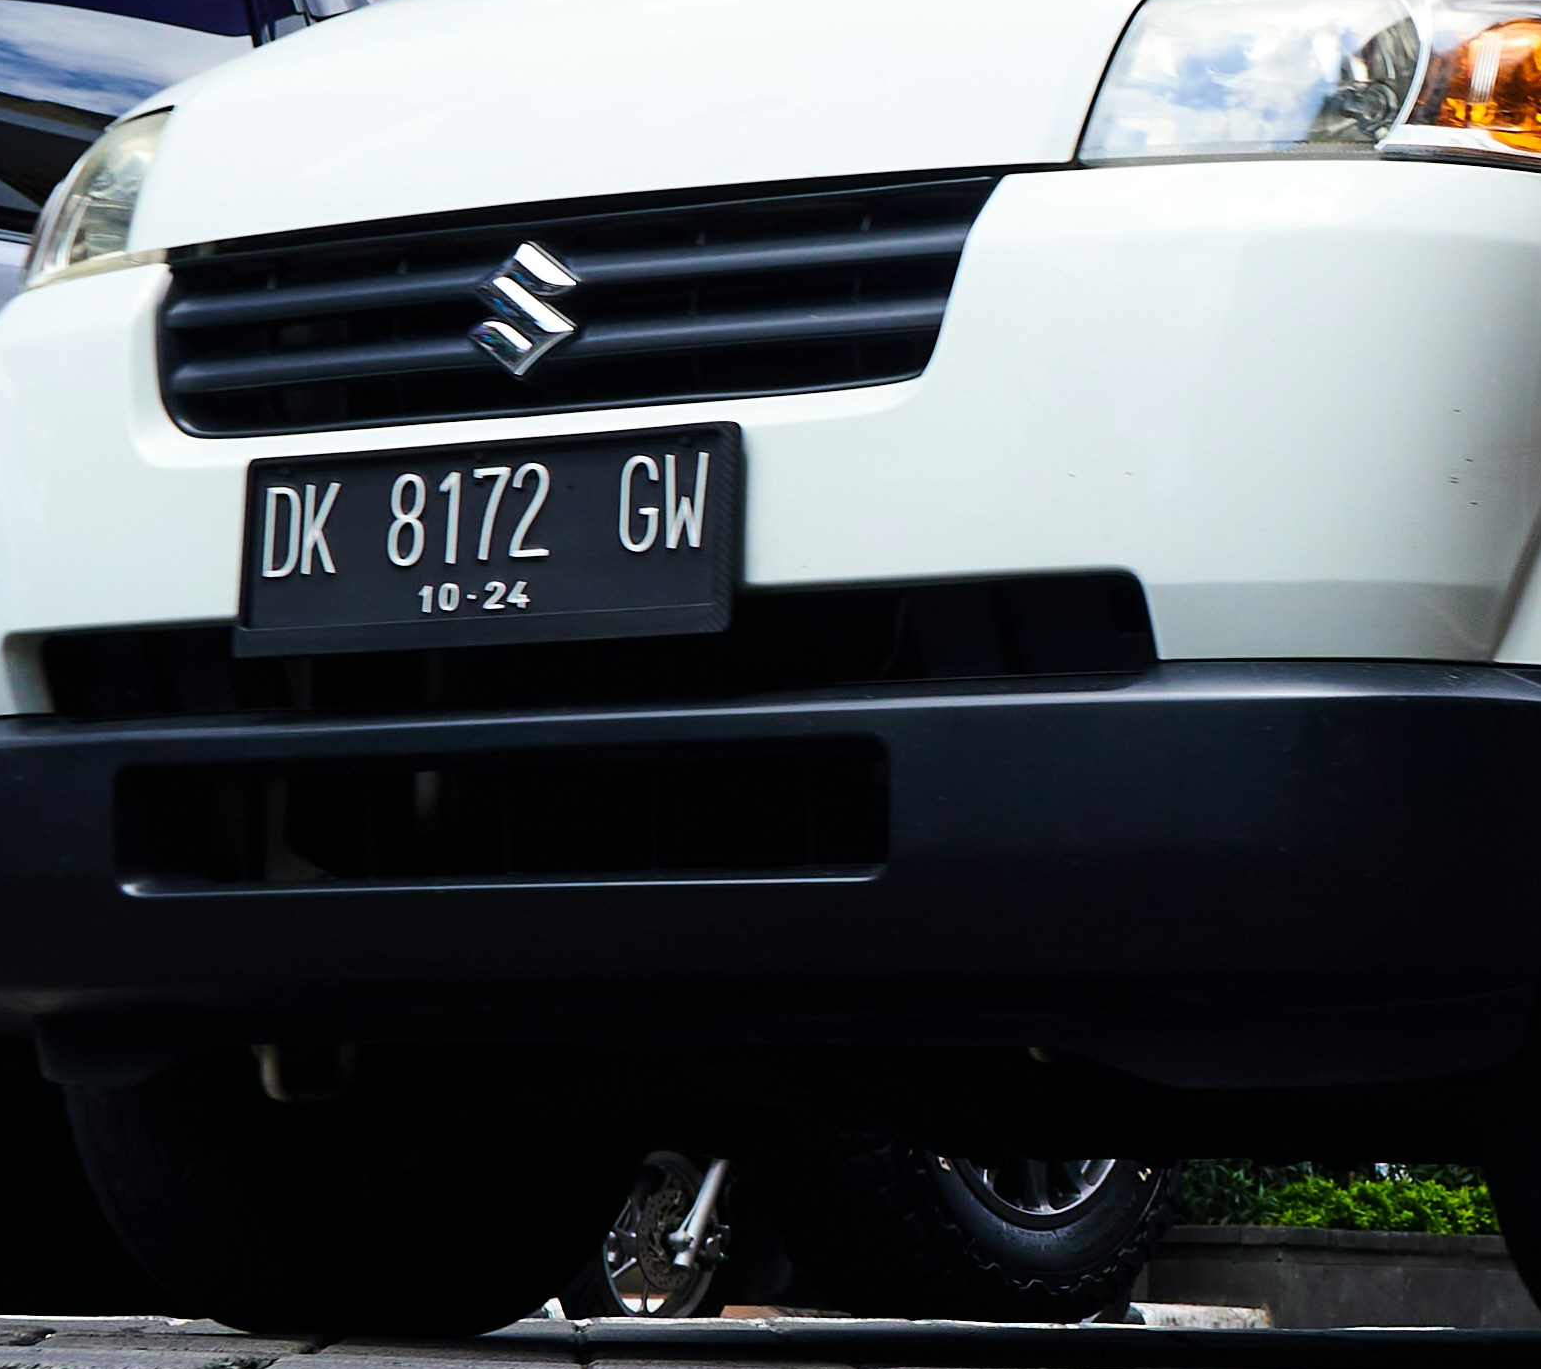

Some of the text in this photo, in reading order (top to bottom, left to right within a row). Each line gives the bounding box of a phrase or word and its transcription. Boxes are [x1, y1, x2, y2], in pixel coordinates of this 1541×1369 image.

[261, 451, 711, 579] DK 8172 GW
[417, 579, 532, 614] 10-24
